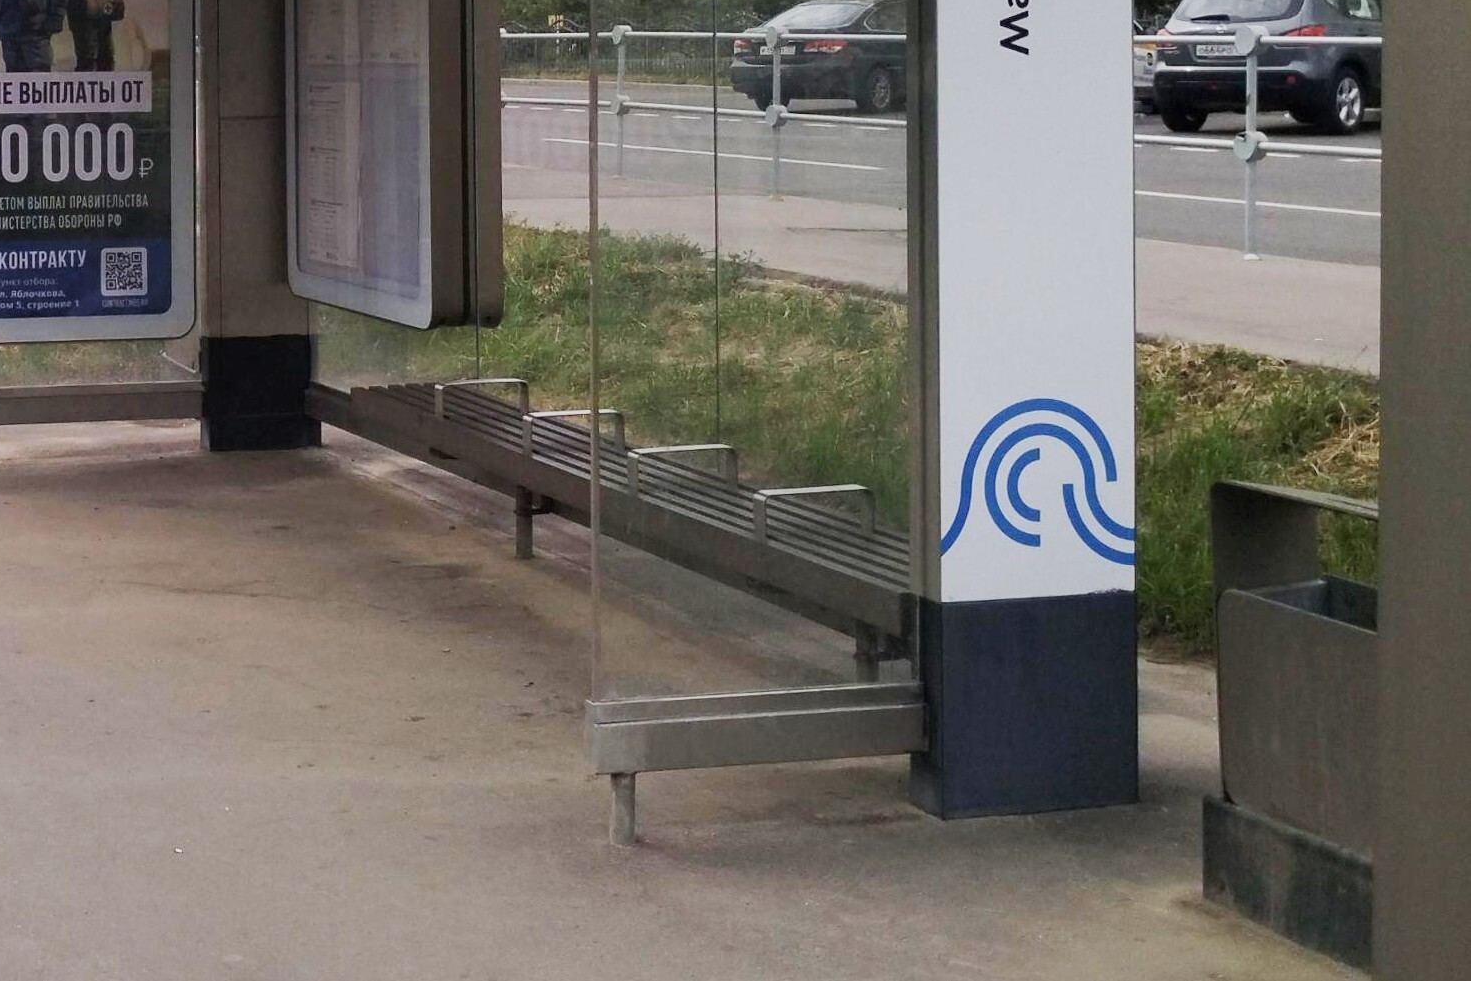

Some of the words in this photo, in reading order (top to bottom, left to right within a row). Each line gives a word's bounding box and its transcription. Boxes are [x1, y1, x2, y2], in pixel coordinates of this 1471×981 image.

[19, 81, 115, 104] ВЫПЛАТЫ
[122, 80, 143, 103] ОТ
[42, 123, 134, 182] 000
[27, 195, 66, 210] ВЫПЛАТ
[69, 194, 149, 209] ПРАВИТЕЛЬСТВА
[58, 214, 105, 228] ОБОРОНЫ
[107, 214, 122, 227] РФ
[27, 300, 72, 311] строение
[74, 299, 80, 307] 1
